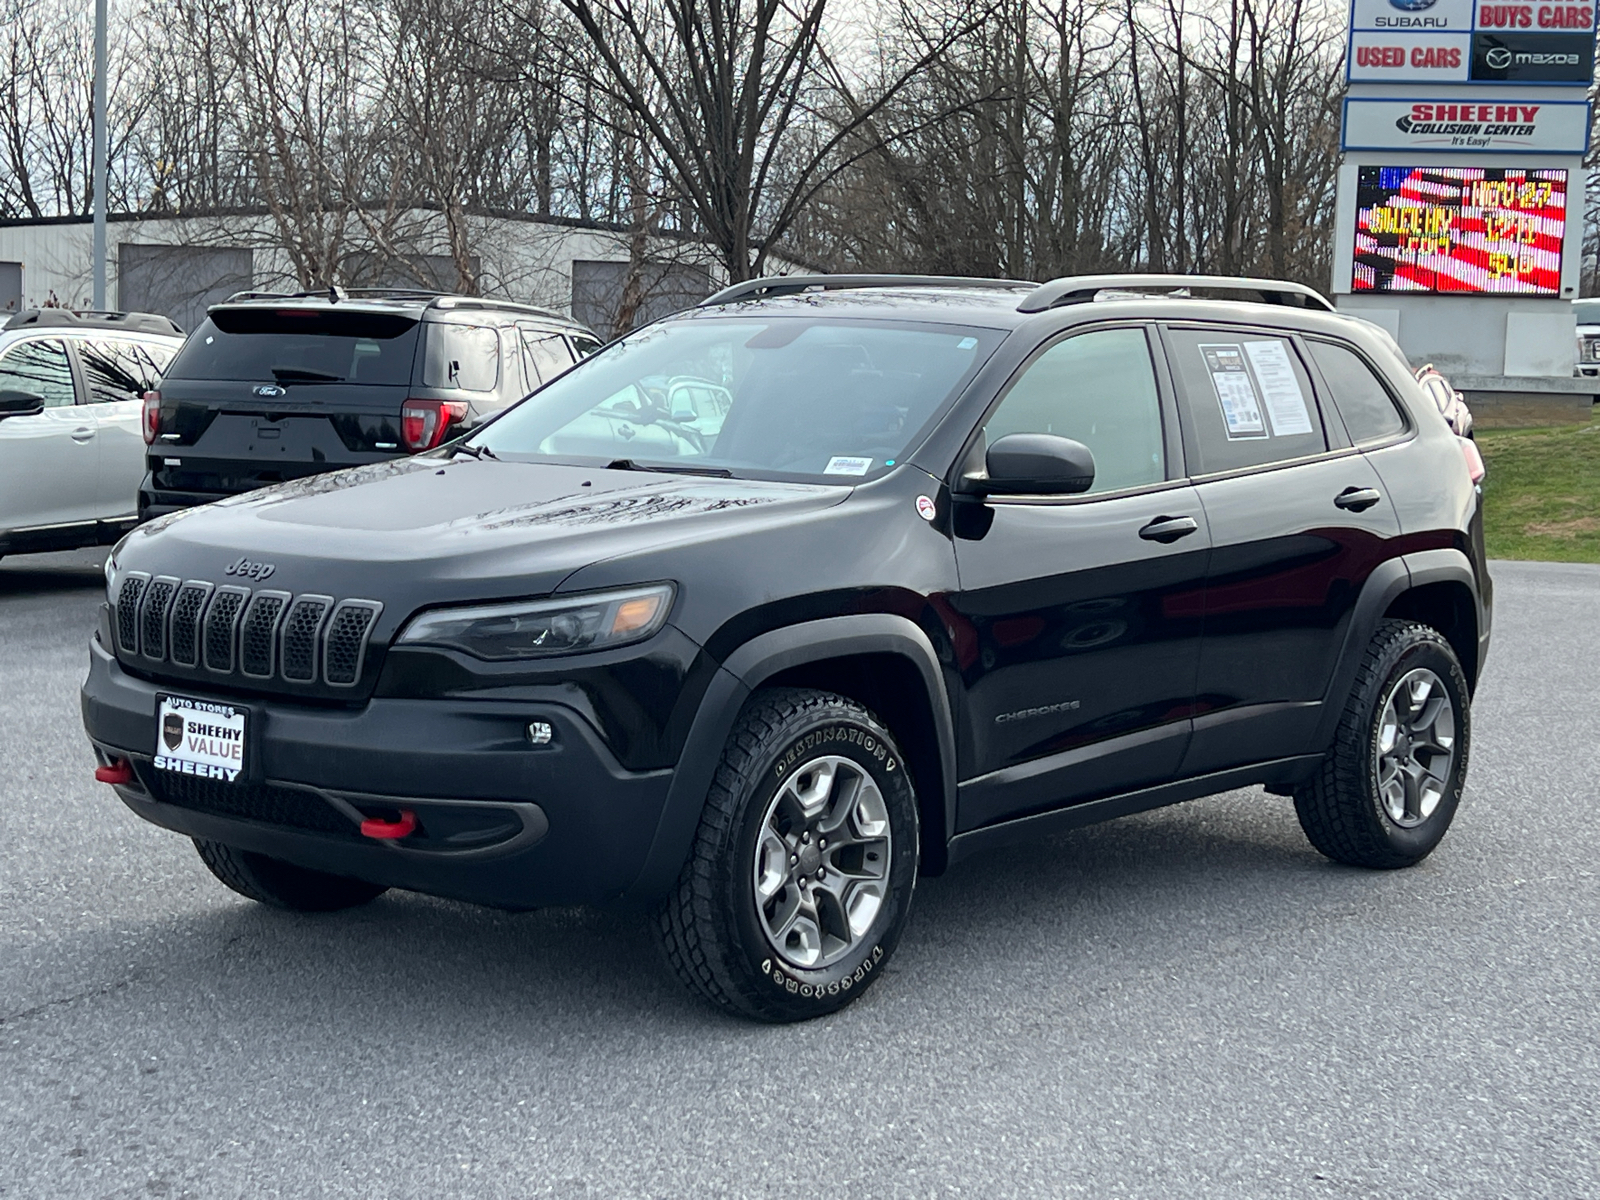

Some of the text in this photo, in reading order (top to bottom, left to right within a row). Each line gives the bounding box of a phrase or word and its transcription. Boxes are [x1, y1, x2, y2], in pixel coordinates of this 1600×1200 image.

[1375, 17, 1448, 28] SUBARU
[1479, 5, 1593, 29] BUYS CARS
[1356, 46, 1462, 69] USED CARS
[1515, 53, 1580, 65] mazda
[1411, 104, 1541, 123] SHEEHY
[1410, 123, 1536, 136] COLLISION CENTER
[1451, 136, 1491, 148] It's Easy!
[224, 556, 276, 582] Jeep
[166, 696, 235, 716] AUTO STORES
[995, 700, 1081, 723] CHEROKEE
[188, 721, 242, 741] SHEEHY
[188, 735, 242, 760] VALUE
[775, 726, 887, 777] DESTINATION
[153, 755, 240, 782] SHEEHY
